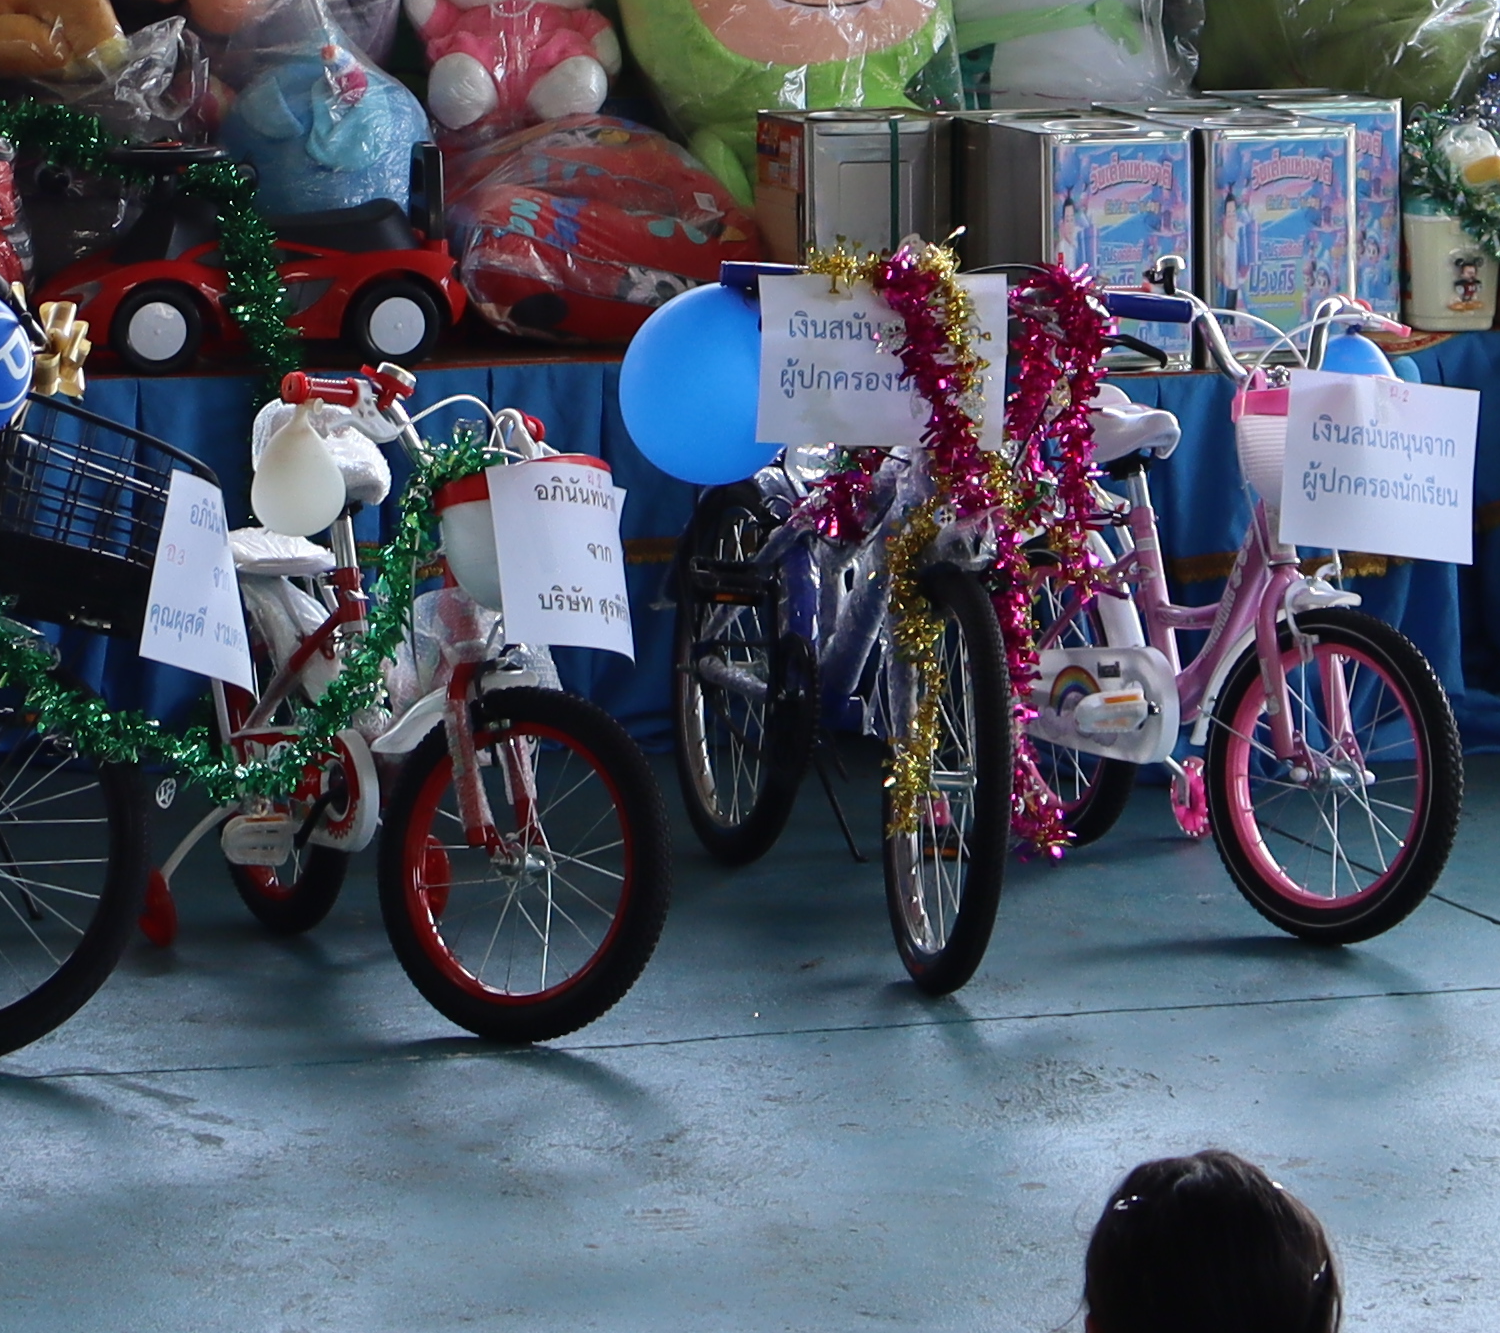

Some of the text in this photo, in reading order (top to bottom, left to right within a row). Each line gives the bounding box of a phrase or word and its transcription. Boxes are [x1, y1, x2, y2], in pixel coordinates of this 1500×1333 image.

[1312, 414, 1456, 461] เงินสนับสนุนจาก
[1302, 461, 1459, 508] ผู้ปกครองนักเรียน
[587, 541, 613, 564] จาก
[537, 584, 594, 614] บริษัท
